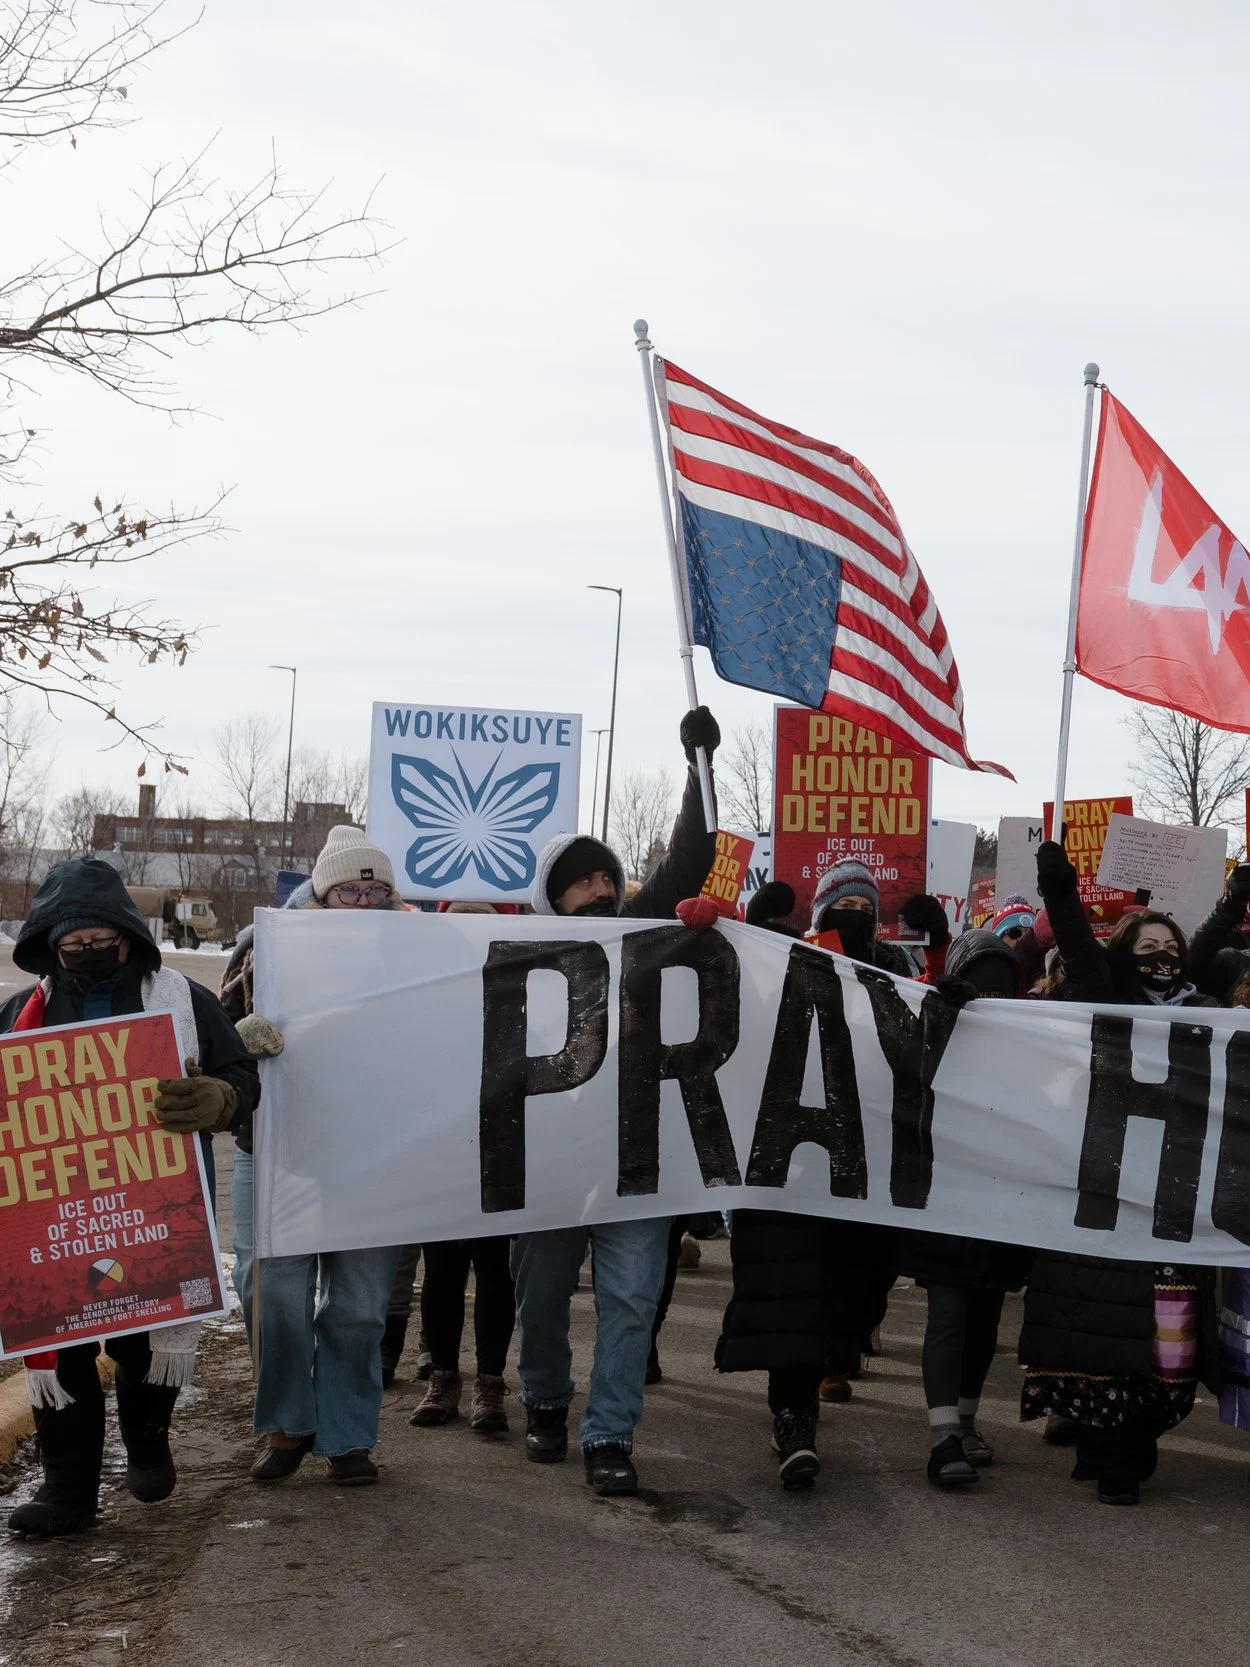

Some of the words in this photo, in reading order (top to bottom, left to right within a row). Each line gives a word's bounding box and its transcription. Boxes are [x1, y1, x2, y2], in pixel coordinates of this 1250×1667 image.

[384, 708, 572, 747] WOKIKSUYE
[791, 754, 913, 795] HONOR
[782, 794, 921, 835] DEFEND
[1062, 800, 1115, 826] PRAY
[716, 832, 740, 856] AY
[827, 838, 846, 851] ICE
[850, 839, 875, 851] OUT
[817, 852, 832, 864] OF
[802, 866, 811, 878] &
[873, 868, 898, 880] AND
[1079, 877, 1091, 886] ICE
[1079, 893, 1103, 903] TOLEN
[1104, 892, 1124, 901] LAND
[1, 1028, 130, 1096] PRAY
[480, 925, 968, 1213] PRAY
[58, 1200, 87, 1220] ICE
[92, 1192, 127, 1214] OUT
[47, 1222, 70, 1241] OF
[76, 1208, 145, 1236] SACRED
[29, 1247, 44, 1264] &
[49, 1232, 118, 1261] STOLEN
[122, 1223, 169, 1248] LAND
[65, 1314, 80, 1324] THE
[82, 1306, 125, 1321] GENOCIDAL
[127, 1298, 160, 1311] HISTORY
[83, 1301, 108, 1312] NEVER
[110, 1294, 140, 1306] FORGET
[55, 1325, 66, 1334] OF
[68, 1318, 103, 1332] AMERICA
[105, 1315, 111, 1324] &
[113, 1311, 133, 1322] FORT
[135, 1303, 172, 1318] SNELLING
